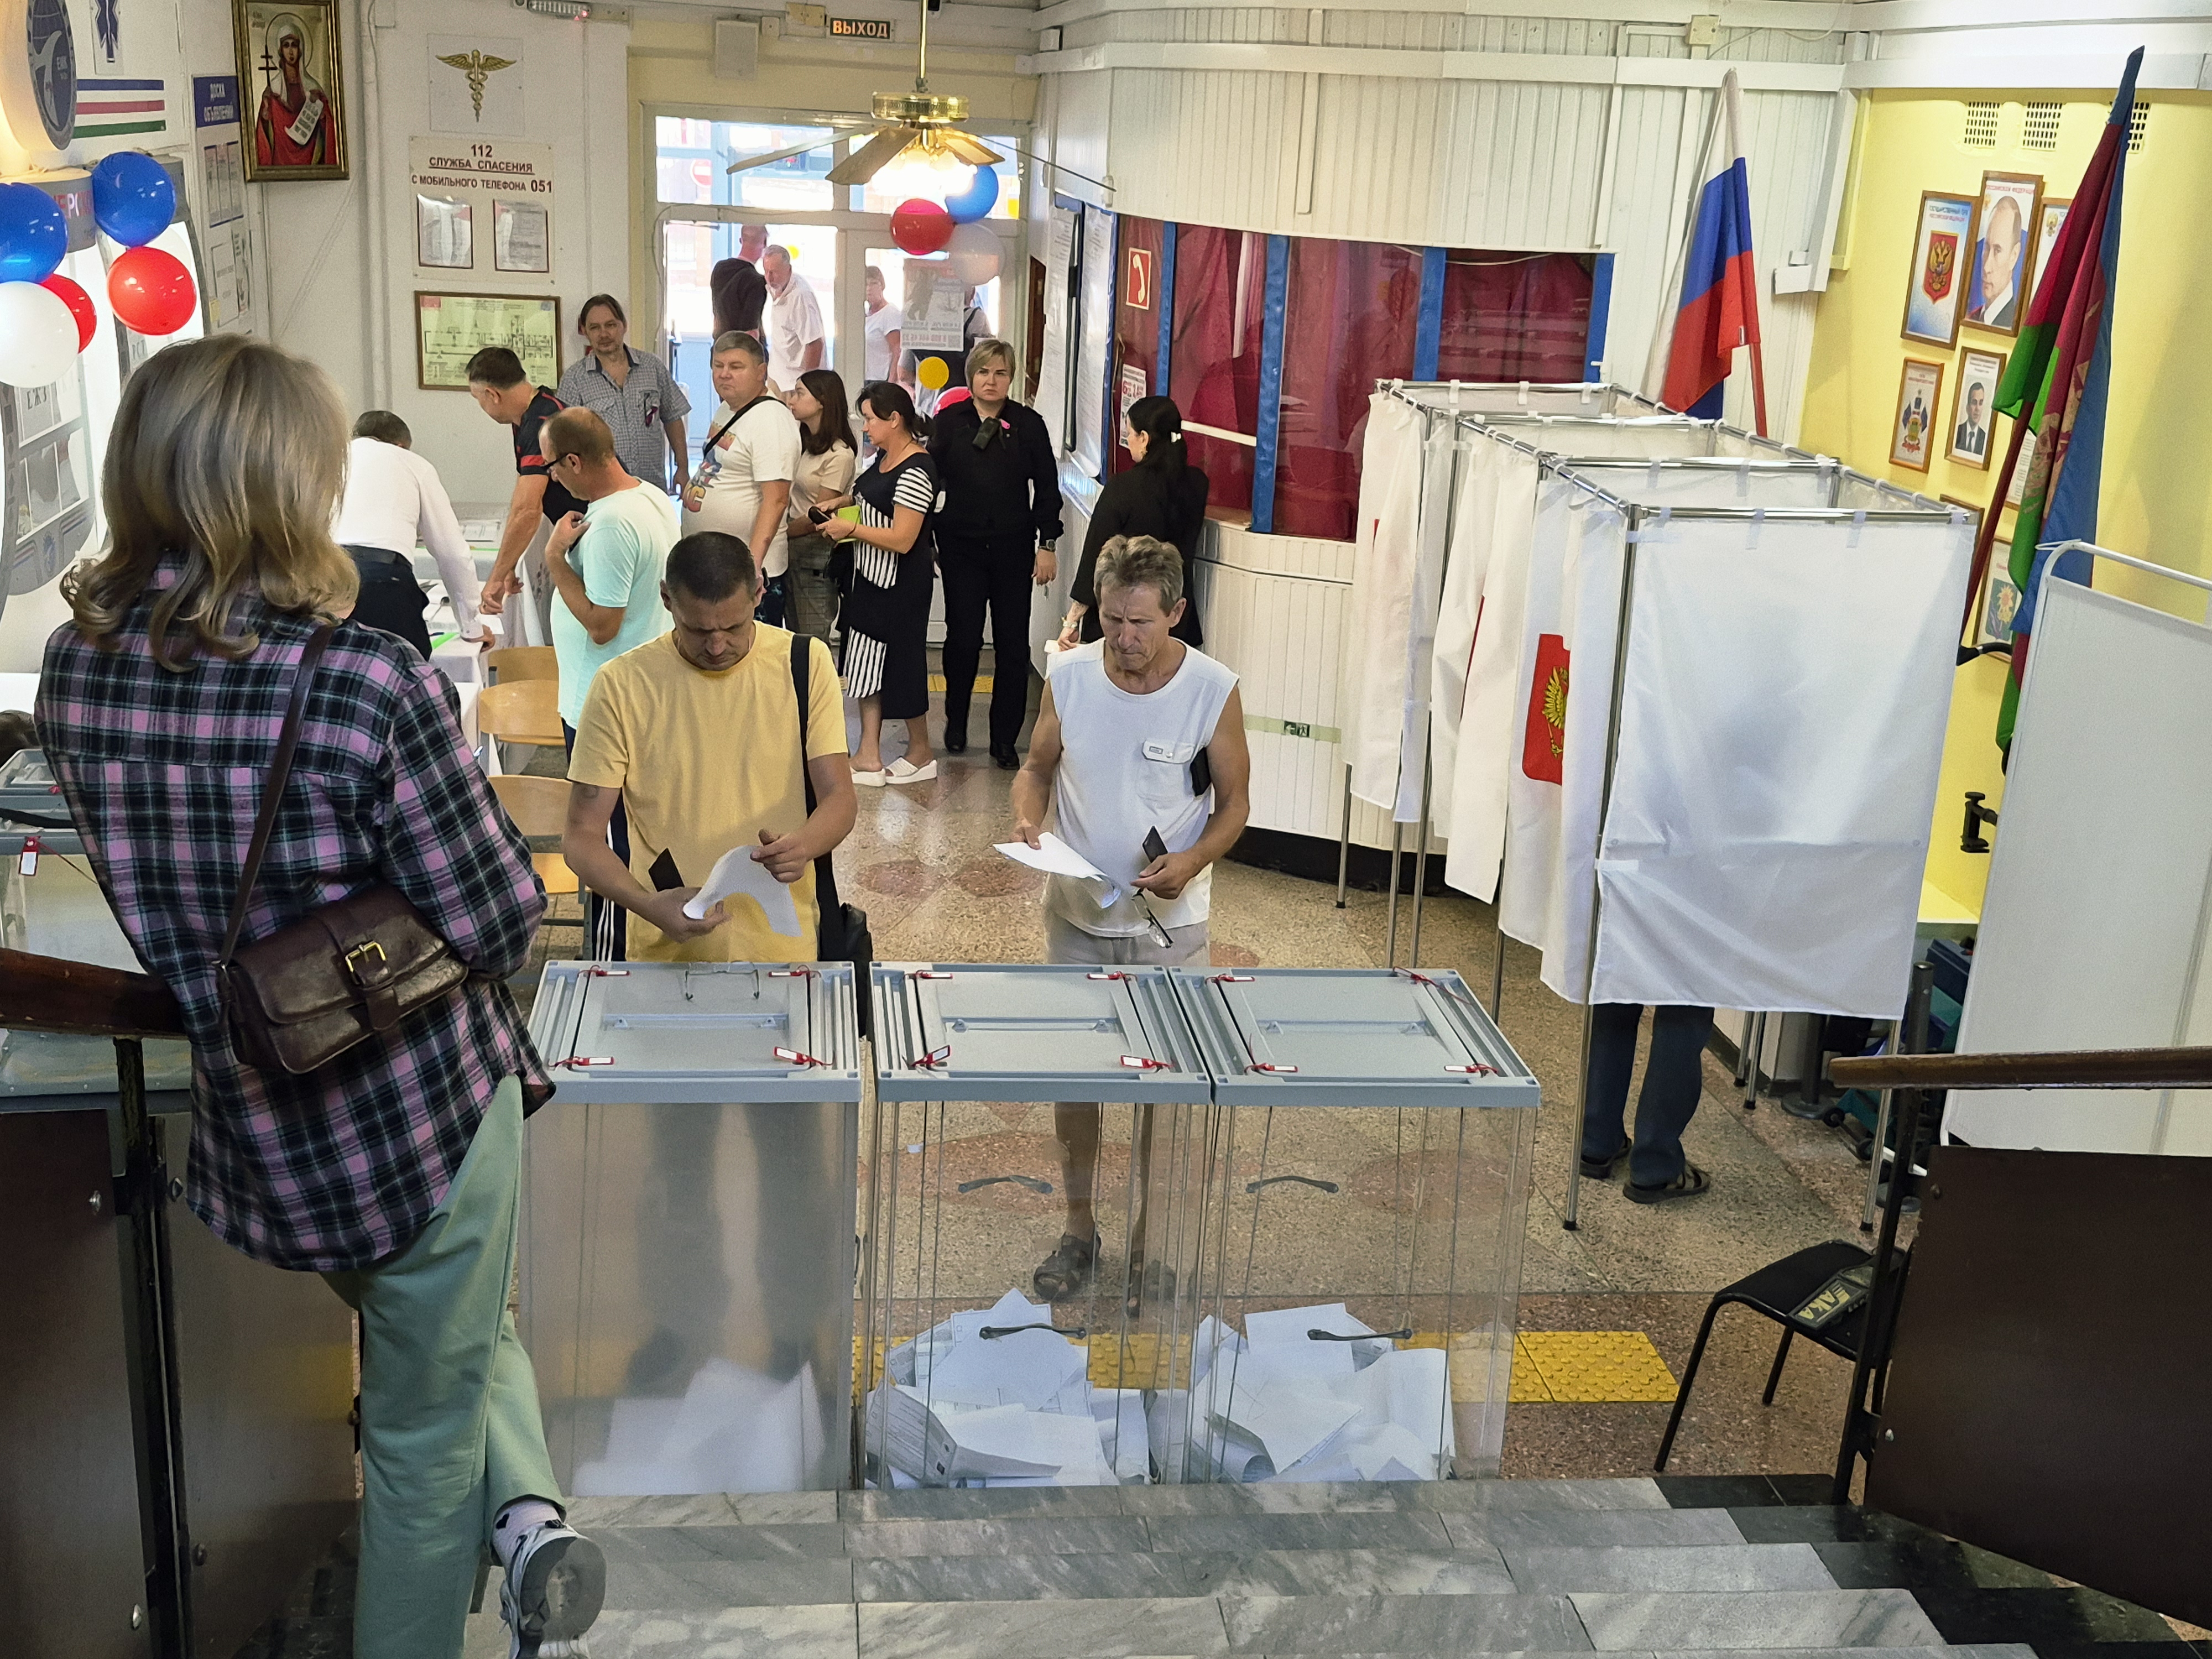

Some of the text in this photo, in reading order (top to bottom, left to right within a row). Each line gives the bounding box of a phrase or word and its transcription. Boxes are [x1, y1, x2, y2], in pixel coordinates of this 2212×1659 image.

[832, 20, 888, 38] ВЫХОД
[471, 143, 493, 158] 112
[429, 156, 533, 173] СЛУЖБА СПАСЕНИЯ
[411, 174, 552, 194] С МОБИЛЬНОГО ТЕЛЕФОНА 051
